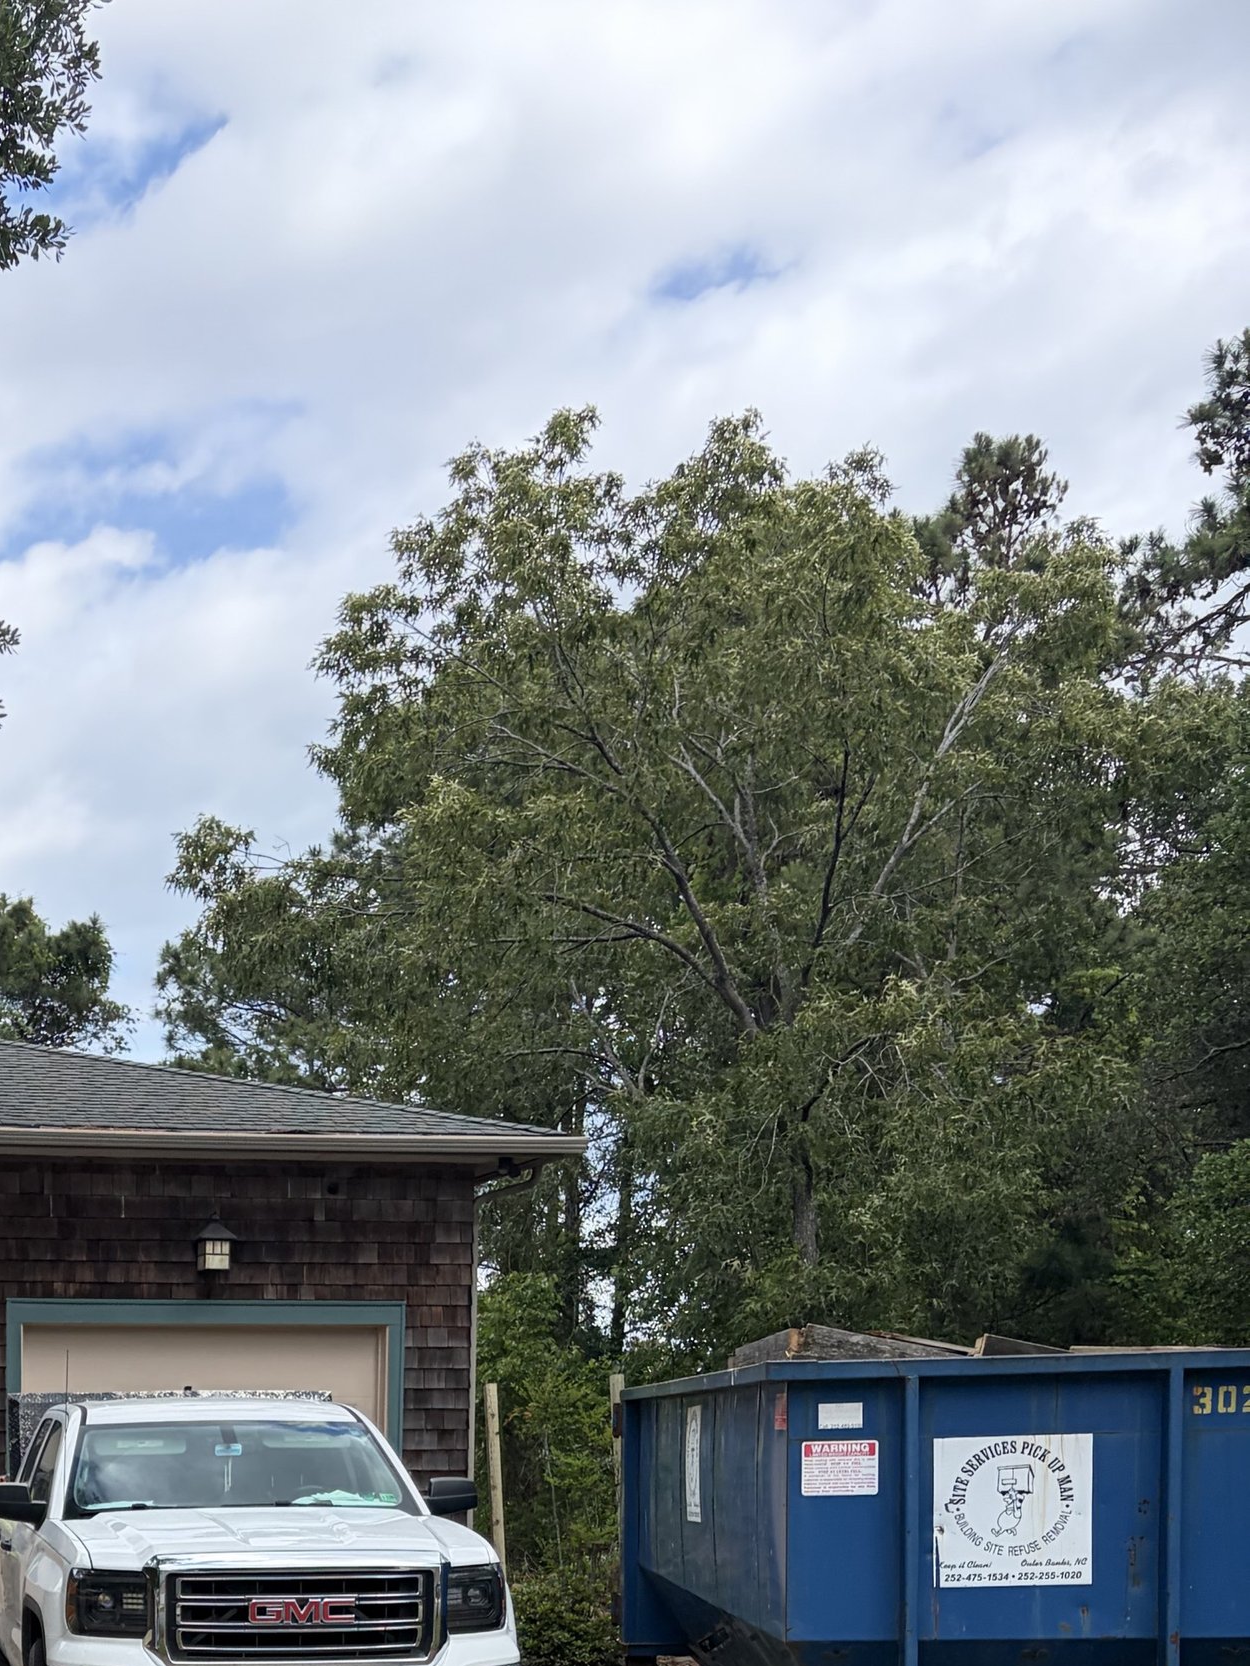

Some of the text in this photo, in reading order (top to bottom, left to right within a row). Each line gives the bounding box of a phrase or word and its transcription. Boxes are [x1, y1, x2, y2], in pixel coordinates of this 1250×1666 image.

[811, 1443, 870, 1453] WARNING
[952, 1440, 1074, 1505] SITE SERVICES PICK UP MAN
[954, 1510, 1072, 1556] BUILDING SITE REFUSE REMOVAL
[1020, 1559, 1044, 1567] Outer
[1074, 1557, 1088, 1566] NC
[944, 1571, 1082, 1582] 252-475-1534 252-255-1020
[248, 1598, 356, 1625] GMC
